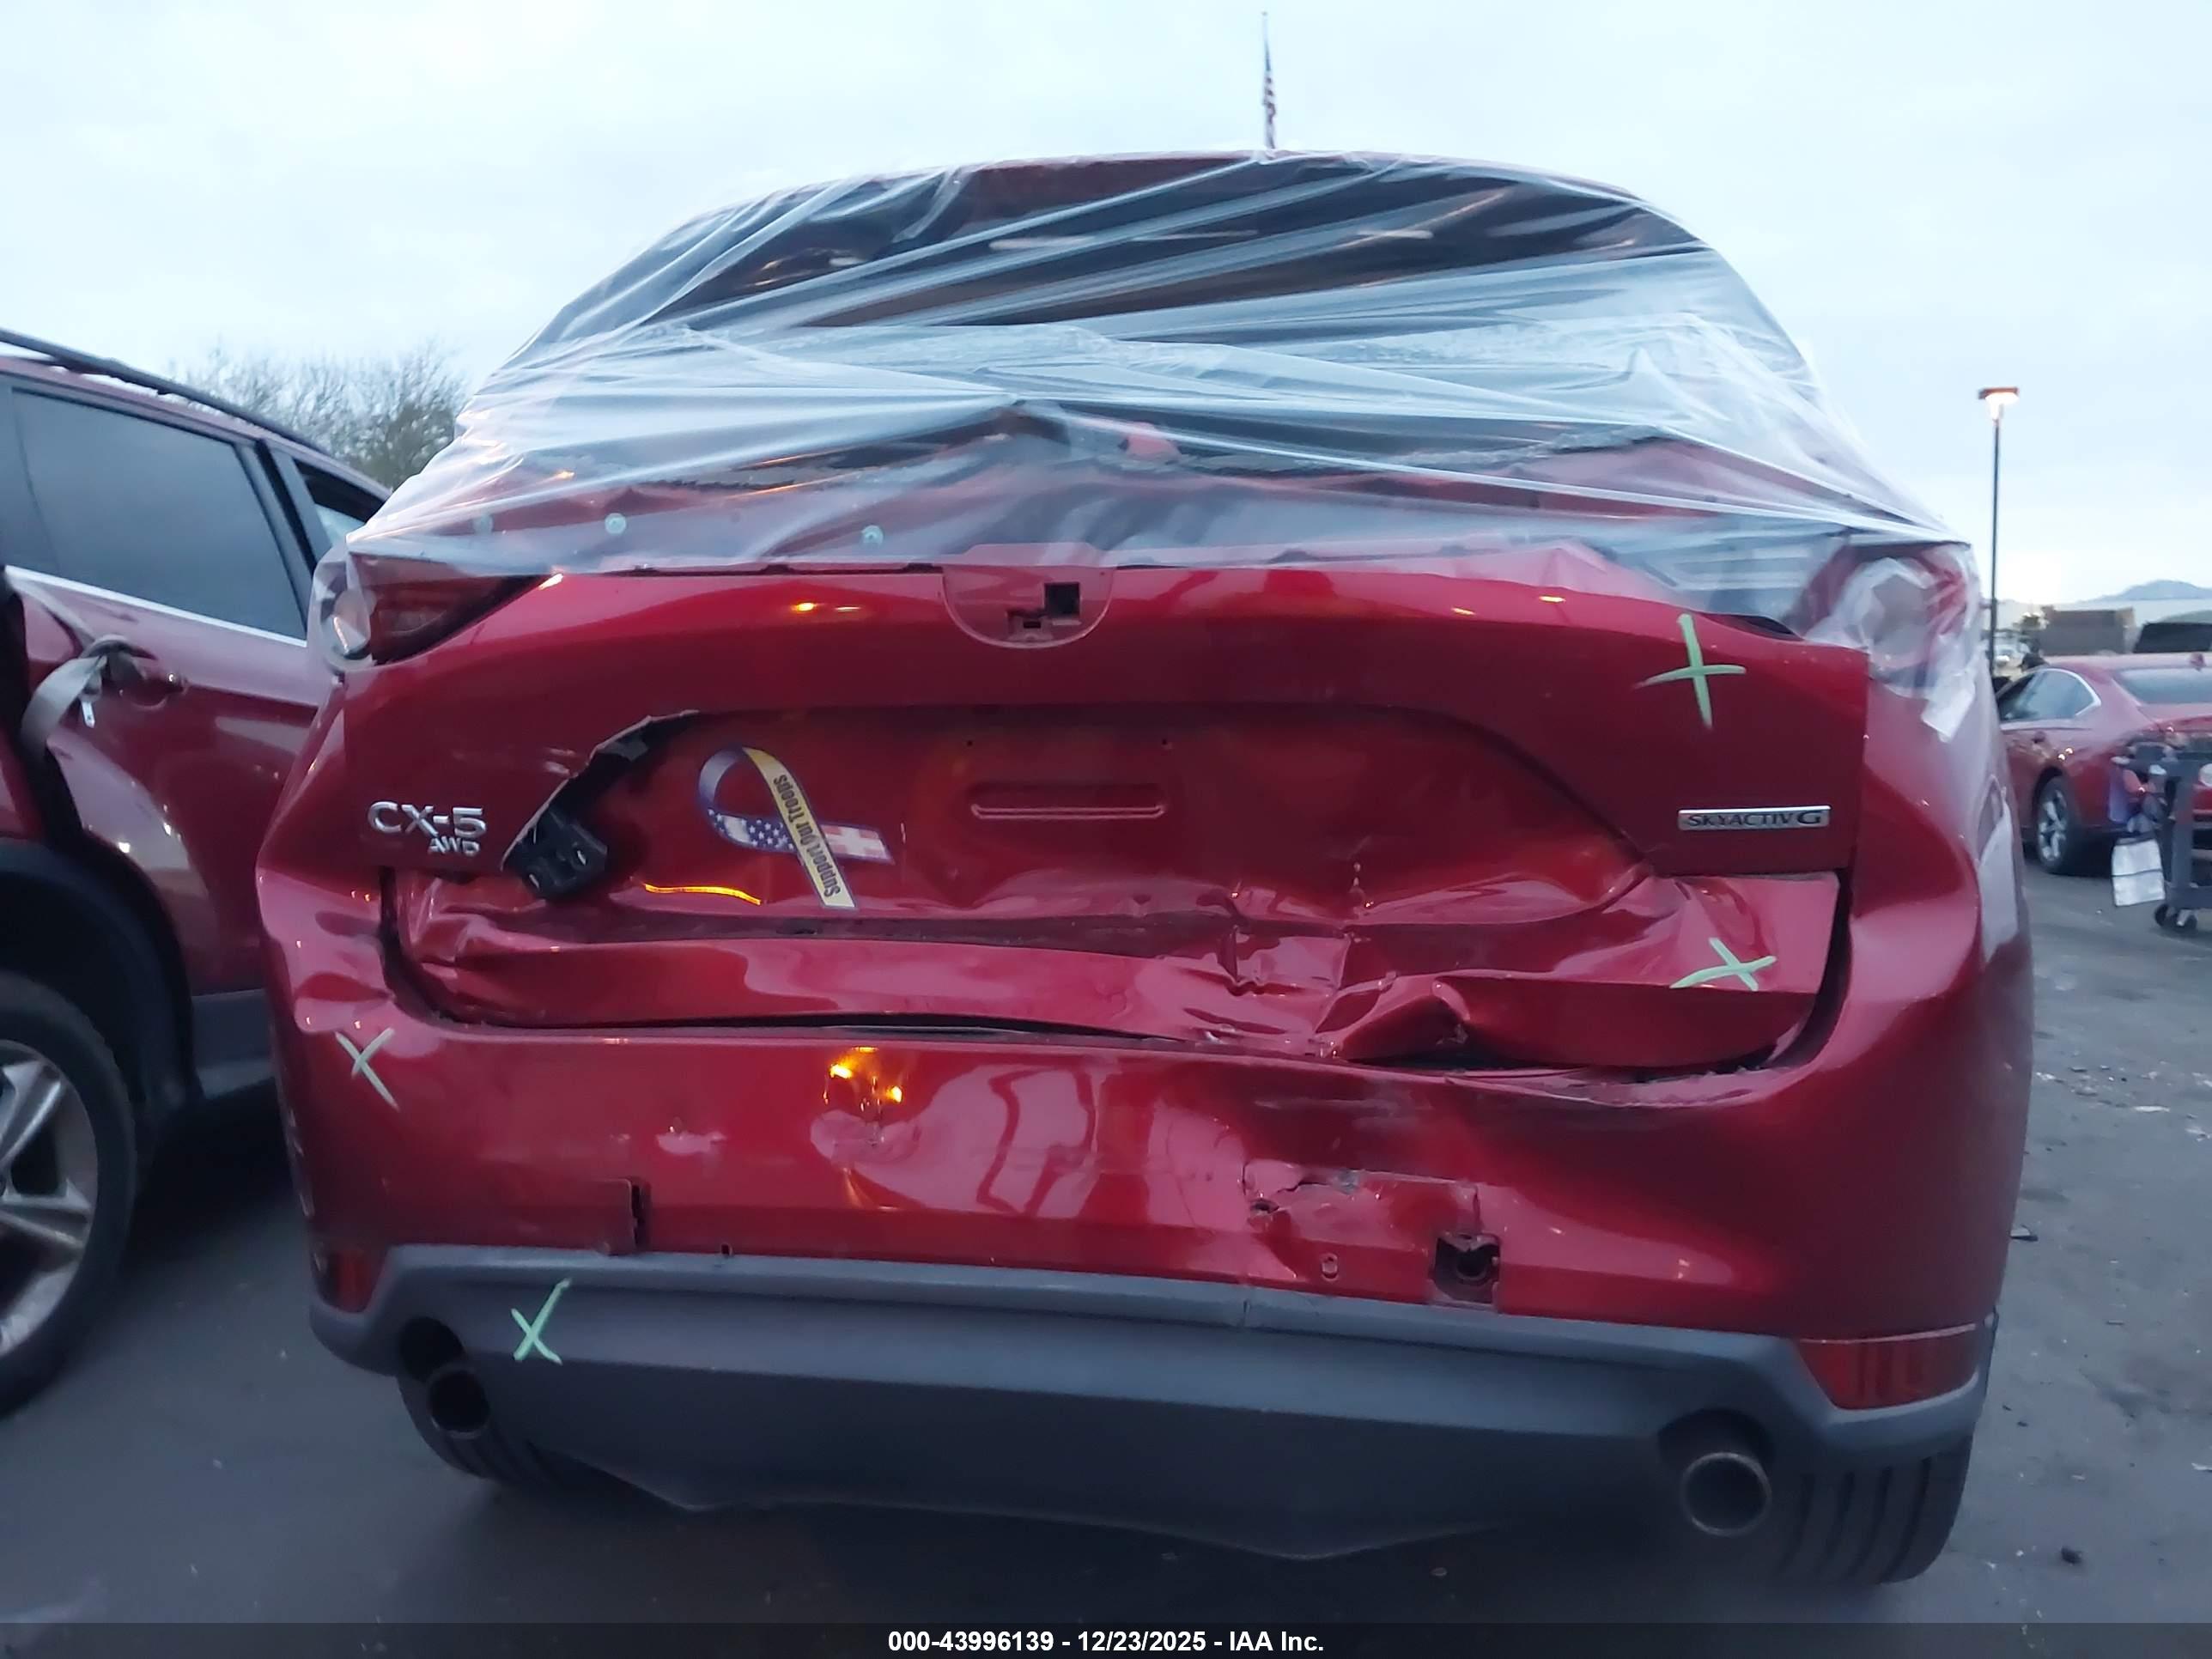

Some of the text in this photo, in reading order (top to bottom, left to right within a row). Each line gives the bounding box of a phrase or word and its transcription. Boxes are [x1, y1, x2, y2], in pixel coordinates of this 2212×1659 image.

[368, 800, 487, 838] CX-5
[773, 775, 841, 897] Support Our Troops
[428, 836, 480, 855] AWD
